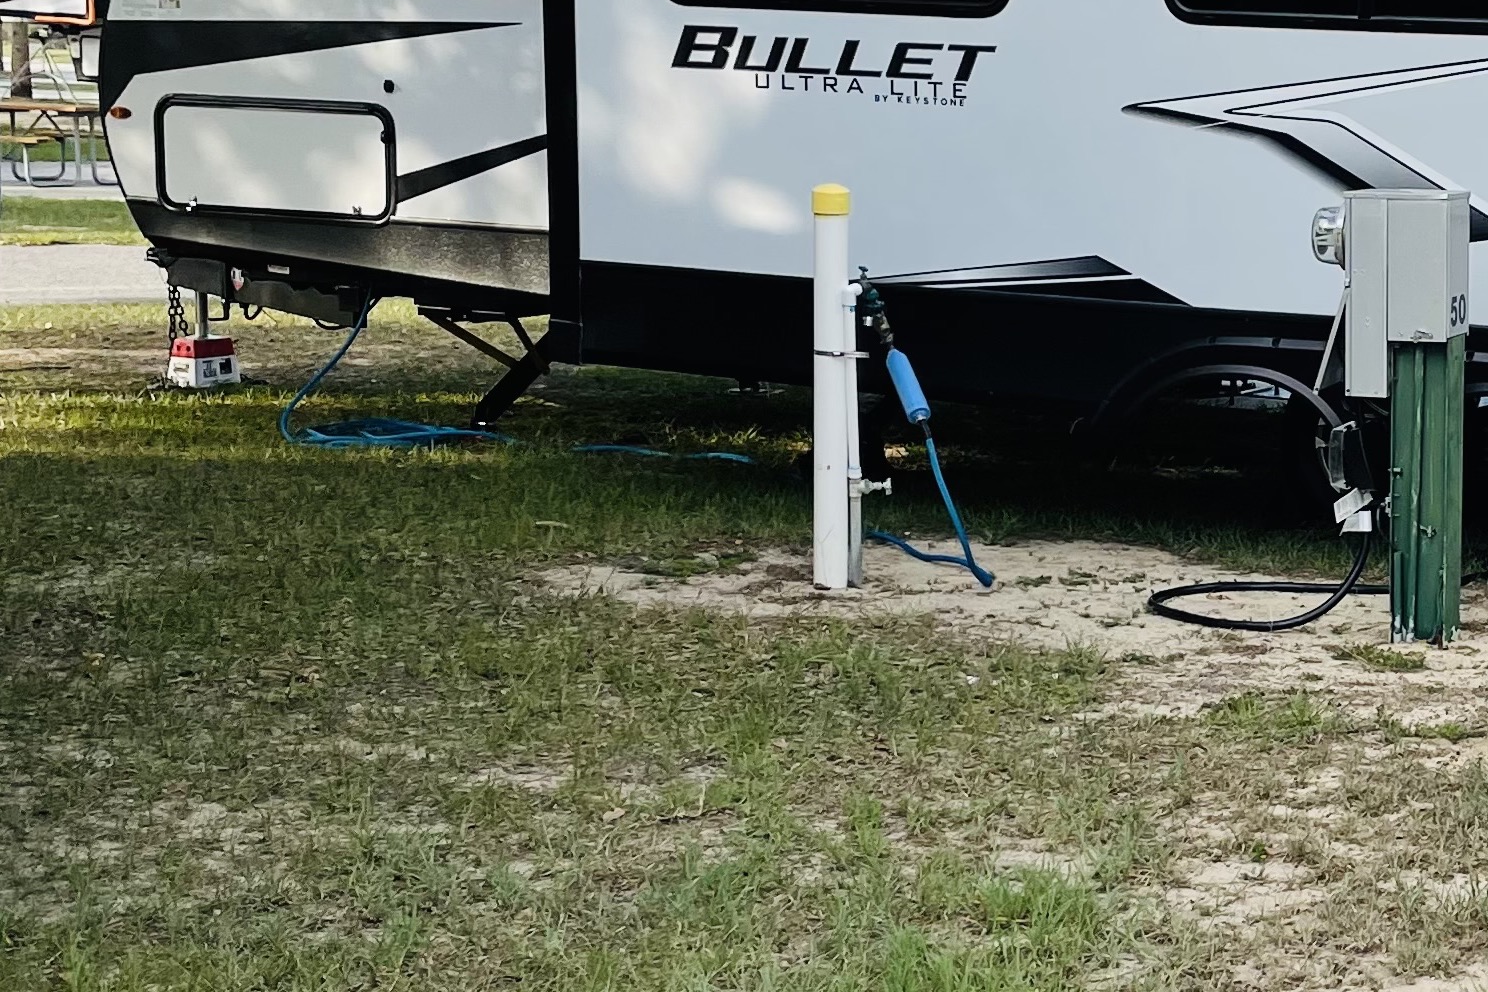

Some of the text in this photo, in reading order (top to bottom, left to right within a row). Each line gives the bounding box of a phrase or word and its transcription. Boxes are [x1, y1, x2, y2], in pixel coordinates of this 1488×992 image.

[671, 25, 997, 82] BULLET
[755, 73, 967, 99] ULTRA LITE
[874, 94, 965, 107] BY KEYSTONE
[1450, 294, 1466, 327] 50
